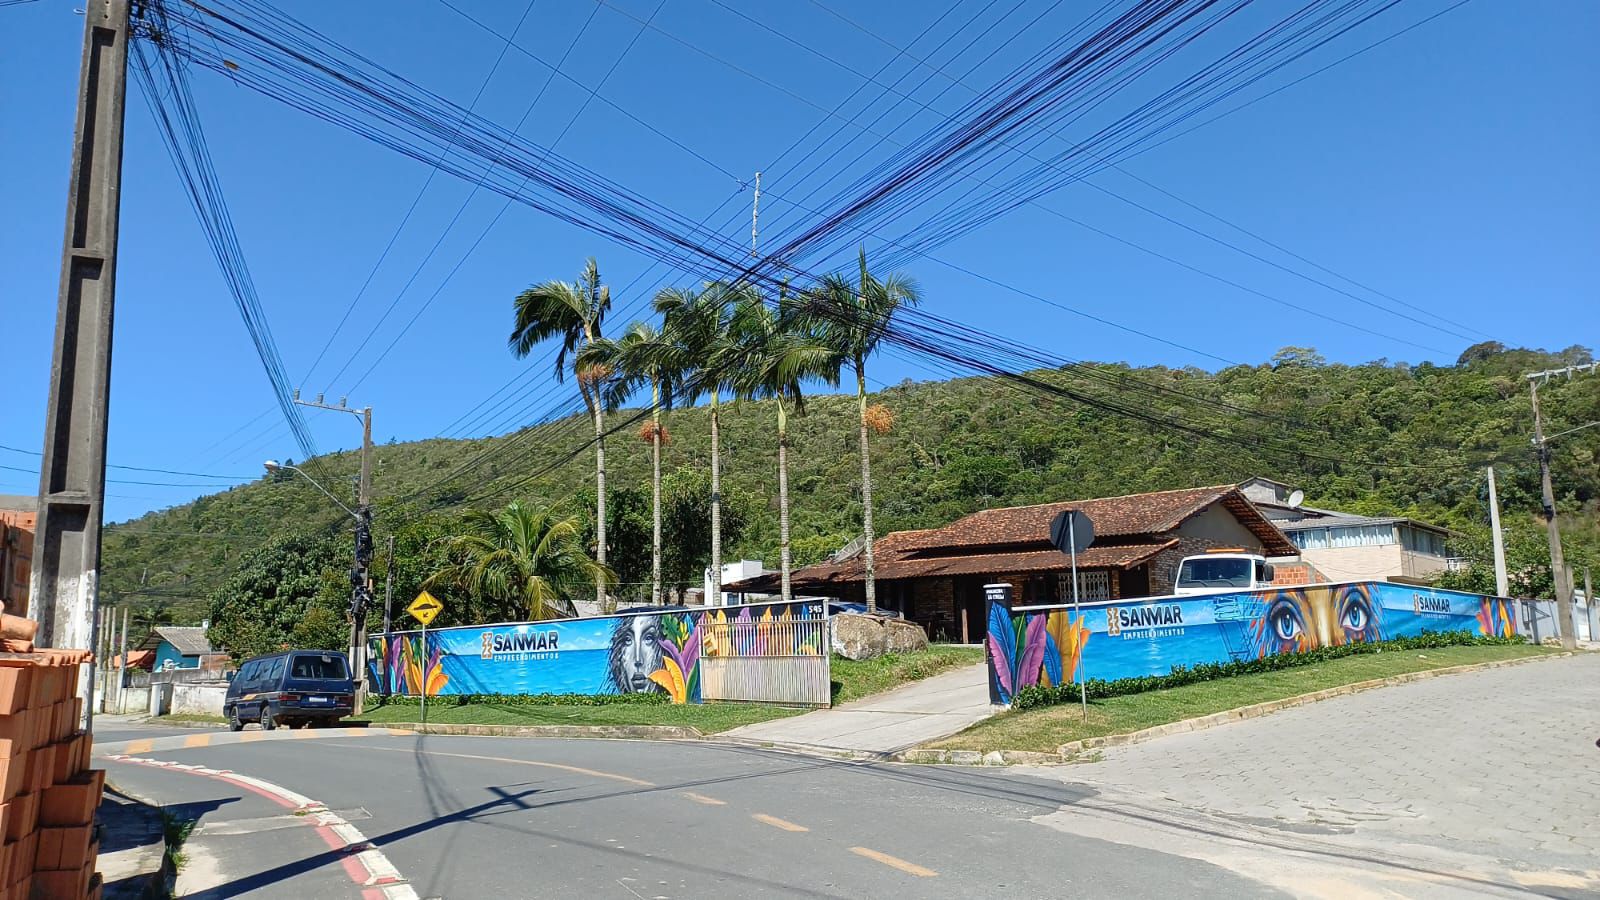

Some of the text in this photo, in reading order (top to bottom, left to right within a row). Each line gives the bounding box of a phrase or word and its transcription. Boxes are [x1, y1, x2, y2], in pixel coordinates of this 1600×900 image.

[1419, 596, 1450, 612] SANMAR
[1120, 605, 1183, 627] SANMAR
[494, 631, 558, 651] SANMAR
